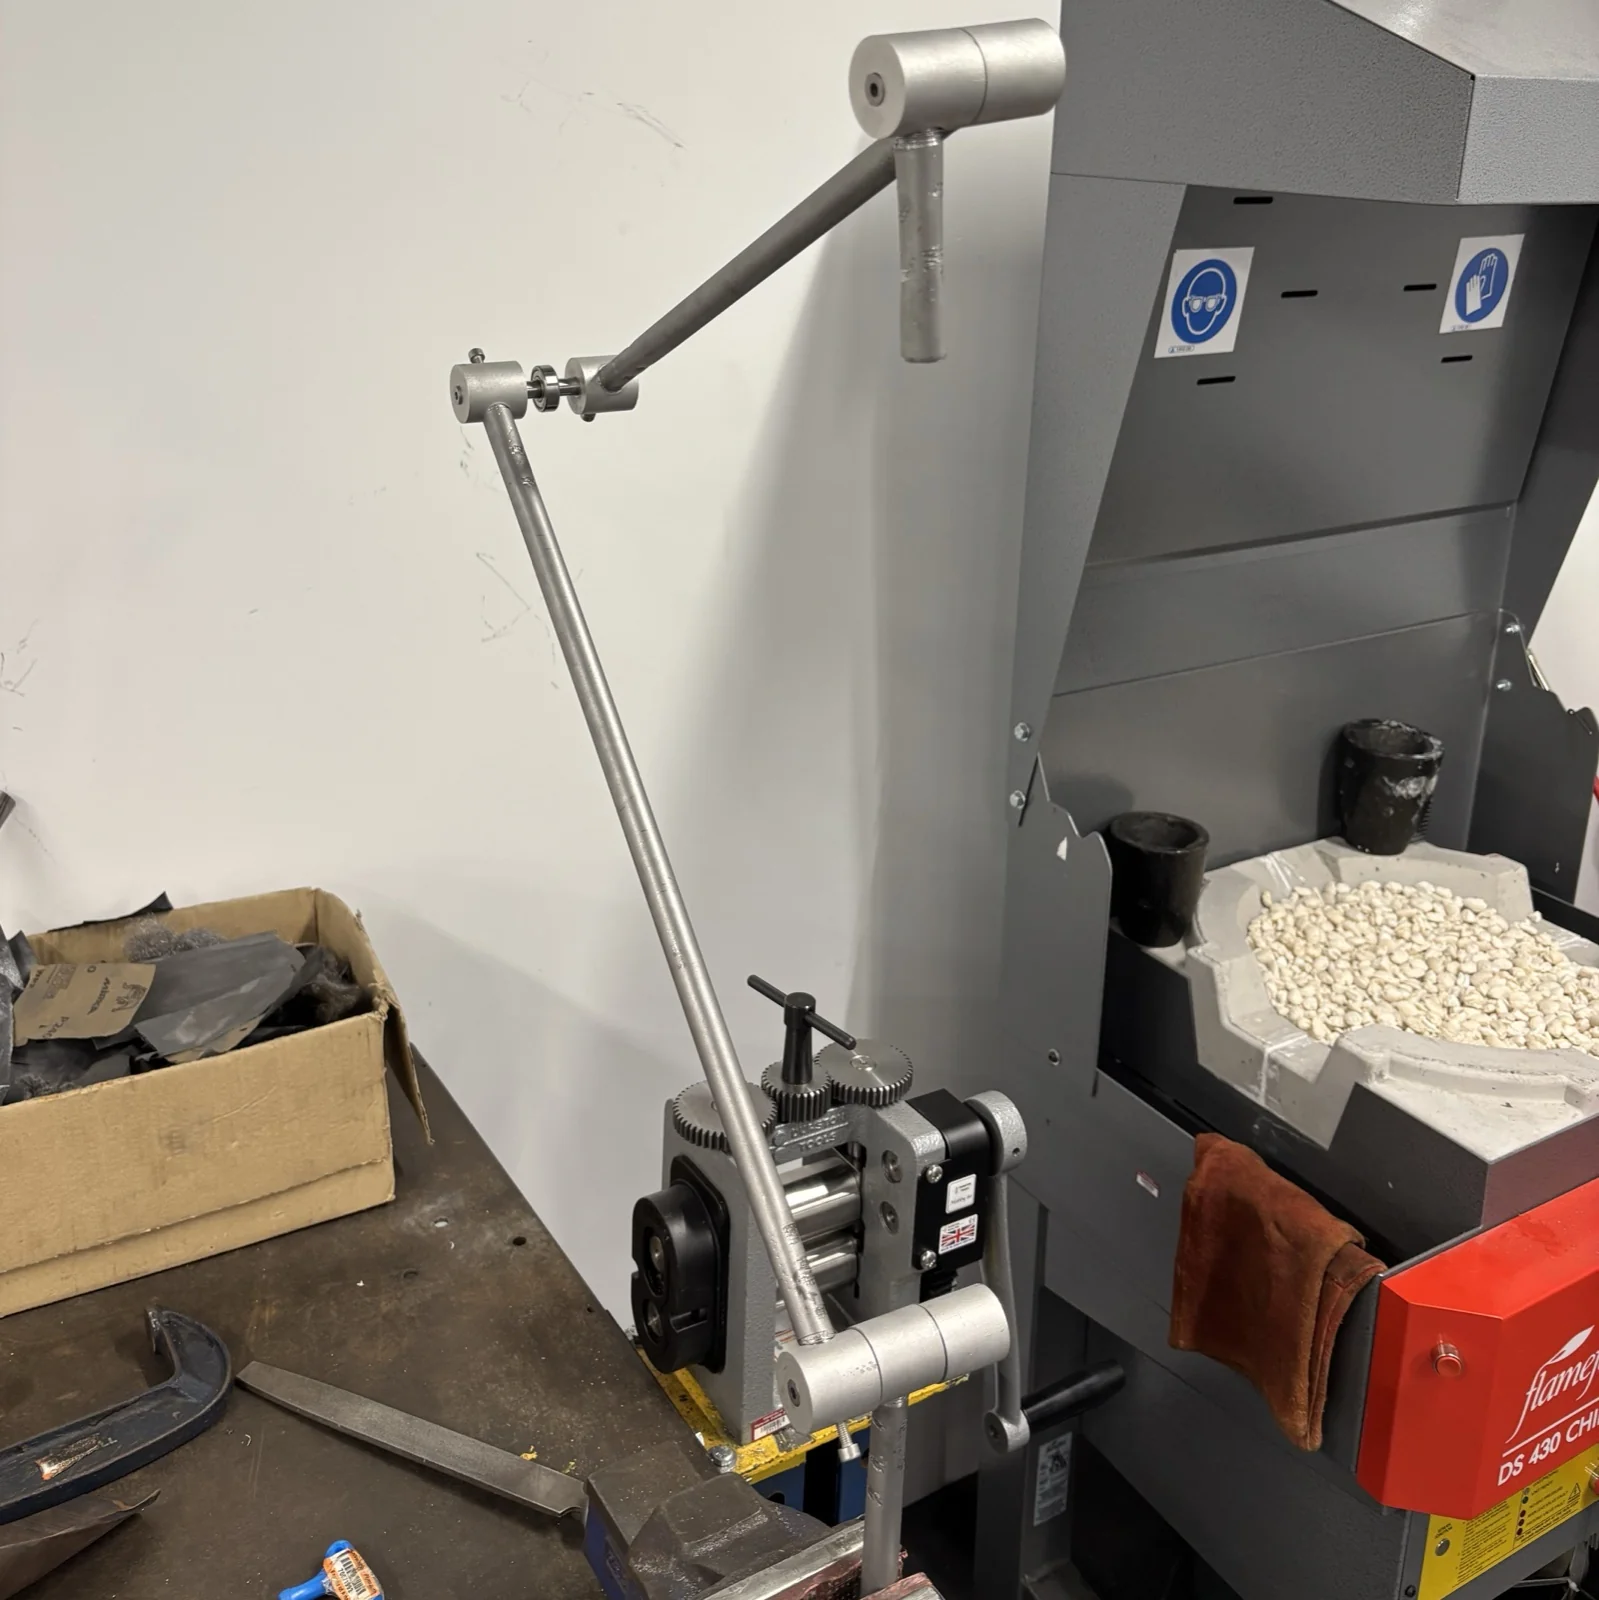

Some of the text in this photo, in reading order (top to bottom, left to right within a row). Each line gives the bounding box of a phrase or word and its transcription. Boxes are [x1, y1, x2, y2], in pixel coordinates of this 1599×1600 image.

[799, 1130, 837, 1151] TOOLS
[1498, 1454, 1525, 1486] DS
[1527, 1431, 1561, 1465] 430
[1565, 1408, 1599, 1443] CHI
